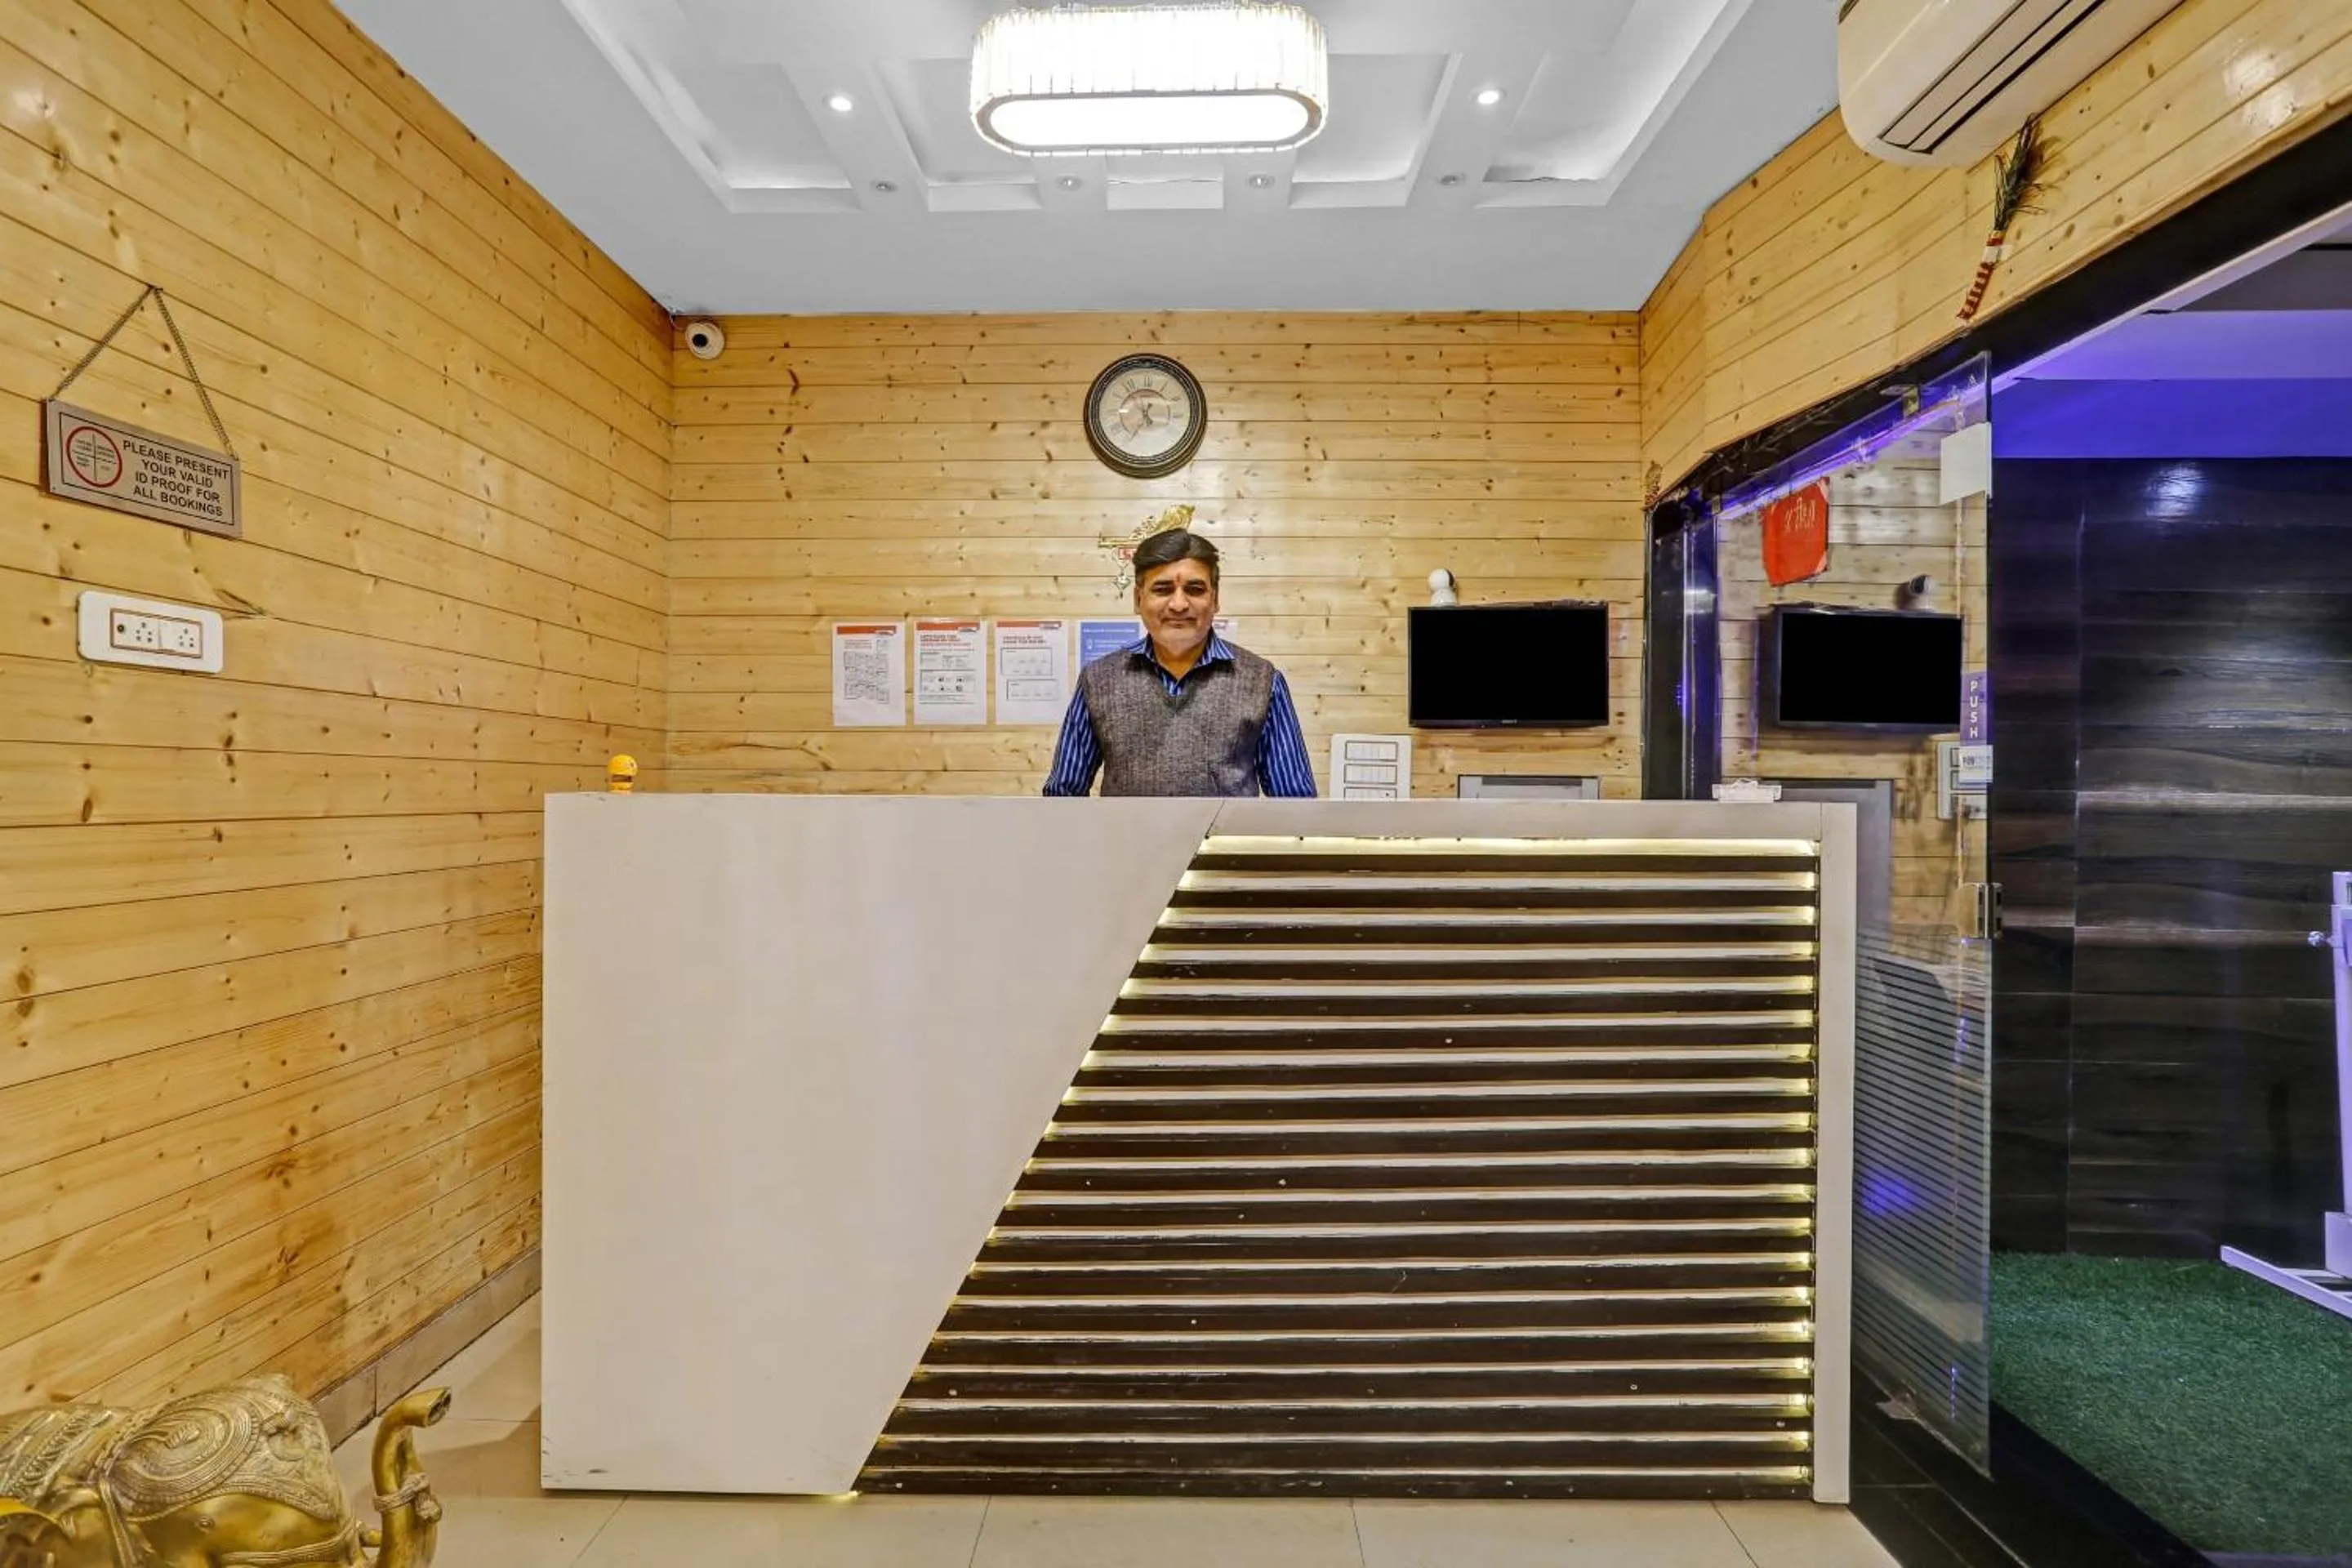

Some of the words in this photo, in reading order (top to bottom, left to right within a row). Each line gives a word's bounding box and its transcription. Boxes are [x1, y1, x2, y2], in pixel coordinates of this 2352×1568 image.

[123, 440, 171, 463] PLEASE
[176, 456, 229, 479] PRESENT
[141, 459, 176, 479] YOUR
[180, 470, 213, 488] VALID
[133, 485, 157, 501] ALL
[161, 492, 223, 516] BOOKINGS
[135, 470, 148, 483] ID
[151, 475, 192, 495] PROOF
[197, 487, 220, 503] FOR
[1970, 680, 1978, 738] PUSH
